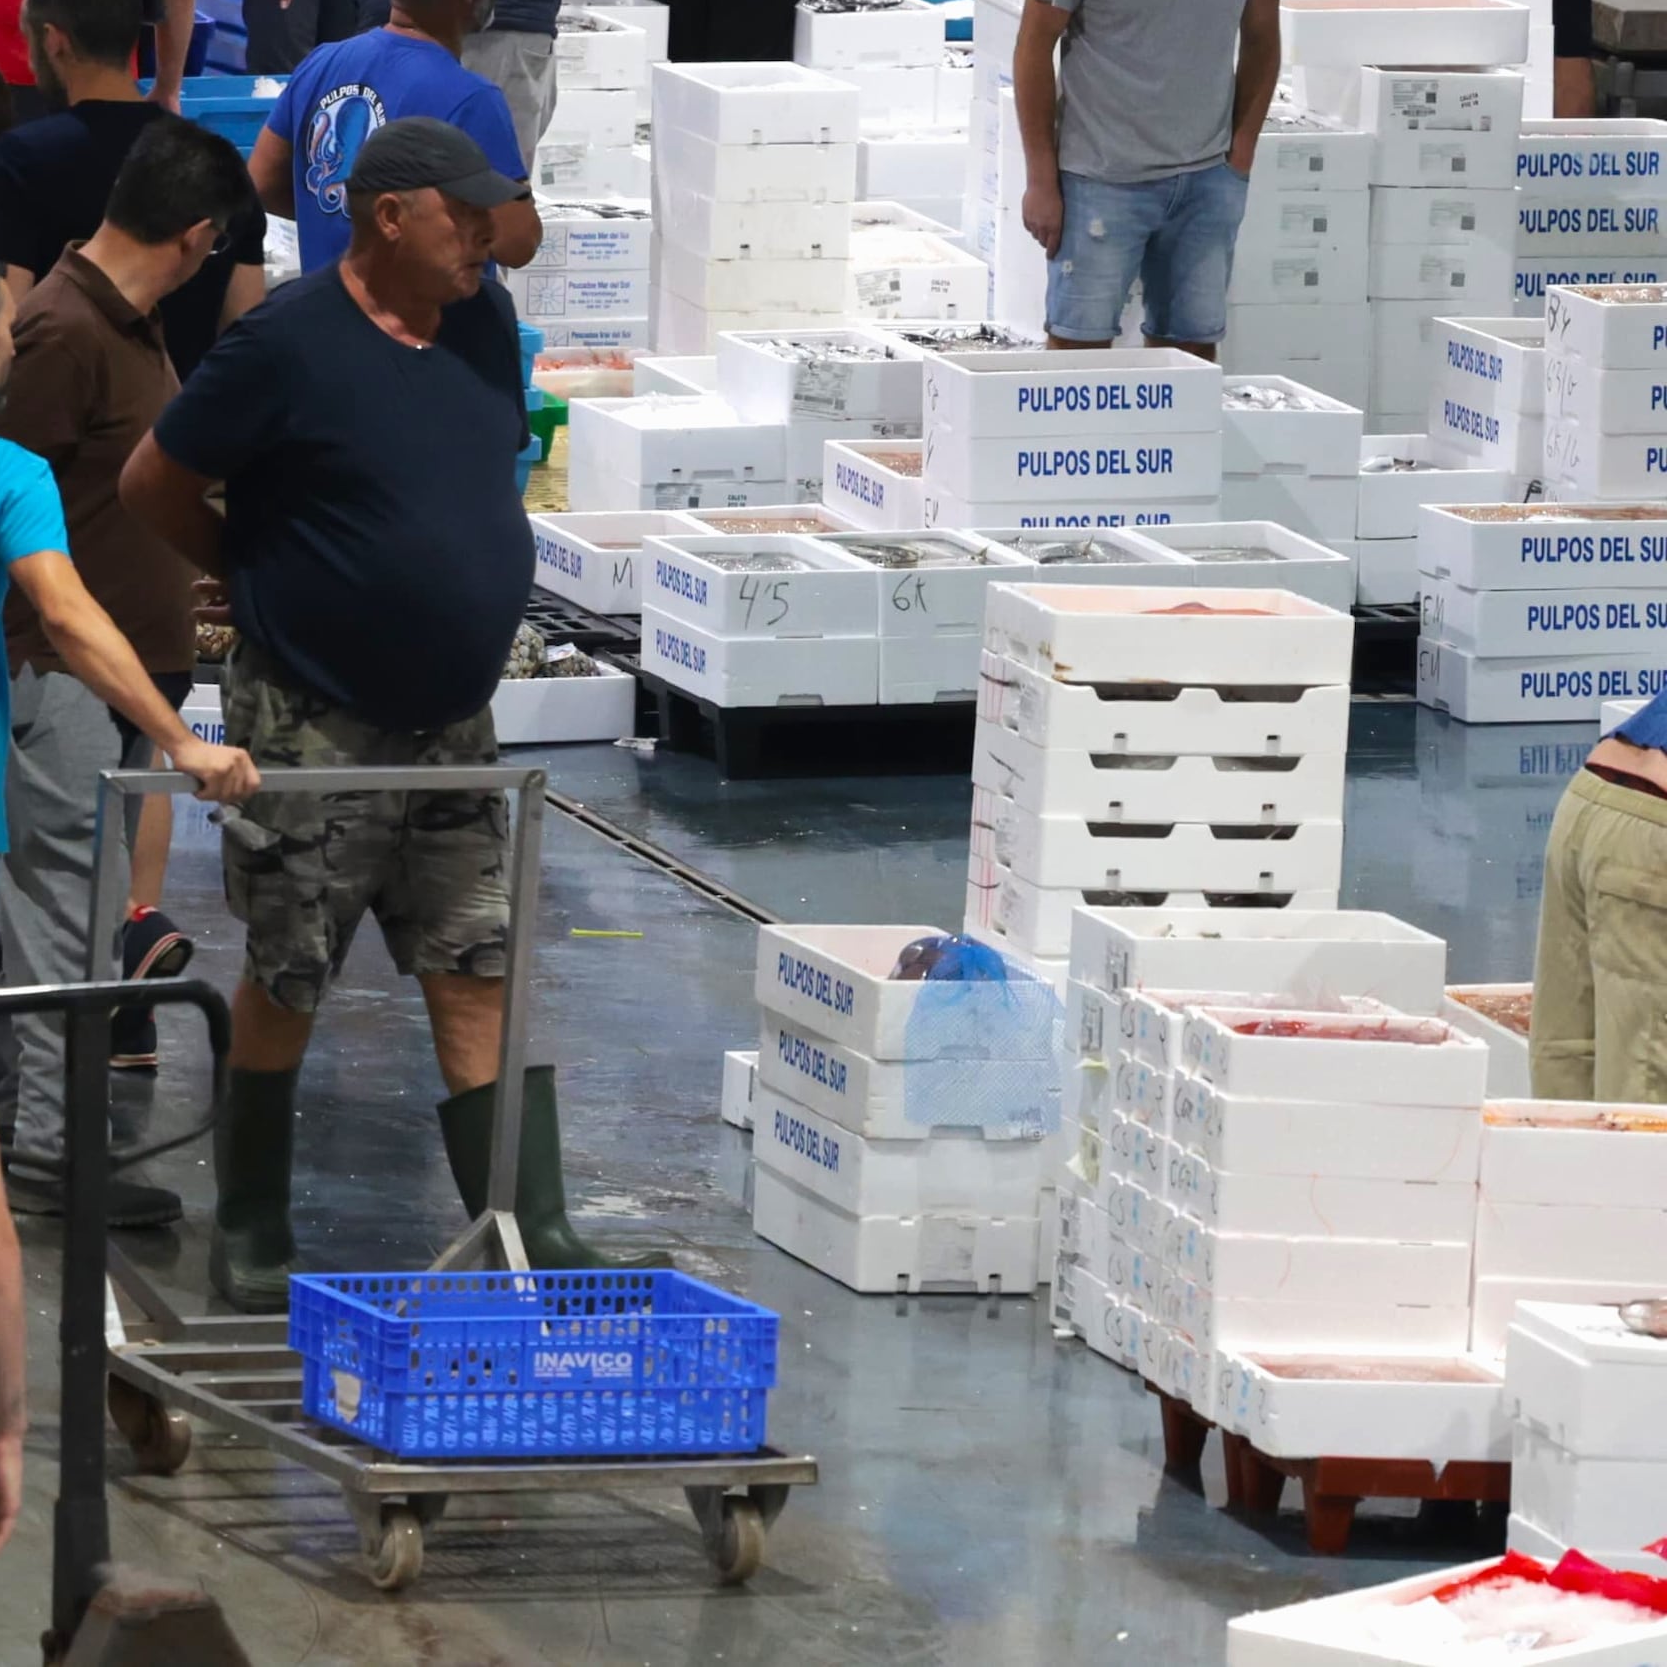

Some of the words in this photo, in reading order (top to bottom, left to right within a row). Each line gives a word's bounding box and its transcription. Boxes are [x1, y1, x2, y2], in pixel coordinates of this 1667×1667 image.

[1516, 152, 1583, 177] PULPOS
[1588, 152, 1621, 176] DEL
[1625, 151, 1660, 176] SUR
[1587, 208, 1620, 233] DEL
[1624, 207, 1660, 234] SUR
[1448, 340, 1474, 376] PULPOS
[1475, 351, 1488, 379] DEL
[1489, 354, 1503, 383] SUR
[1018, 385, 1091, 413] PULPOS
[1096, 384, 1132, 411] DEL
[1135, 383, 1174, 410] SUR
[1444, 399, 1471, 436] PULPOS
[1470, 409, 1484, 439] DEL
[1485, 415, 1500, 445] SUR
[1018, 449, 1091, 477] PULPOS
[1096, 449, 1132, 475] DEL
[1135, 448, 1174, 474] SUR
[836, 462, 860, 499] PULPOS
[859, 474, 872, 503] DEL
[871, 480, 885, 509] SUR
[558, 545, 572, 574] DEL
[570, 549, 583, 580] SUR
[1521, 536, 1595, 563] PULPOS
[1599, 536, 1635, 562] DEL
[655, 558, 681, 596] PULPOS
[680, 572, 695, 601] DEL
[694, 577, 708, 607] SUR
[1527, 603, 1600, 631] PULPOS
[1605, 603, 1641, 630] DEL
[655, 628, 681, 665] PULPOS
[679, 640, 694, 669] DEL
[693, 646, 707, 675] SUR
[1520, 671, 1593, 698] PULPOS
[1598, 669, 1633, 697] DEL
[777, 952, 815, 998] PULPOS
[814, 969, 834, 1008] DEL
[834, 979, 855, 1017] SUR
[778, 1028, 812, 1076] PULPOS
[811, 1048, 828, 1086] DEL
[829, 1057, 848, 1095] SUR
[774, 1109, 807, 1154] PULPOS
[806, 1126, 823, 1164] DEL
[822, 1136, 840, 1174] SUR
[533, 1351, 633, 1369] INAVICO
